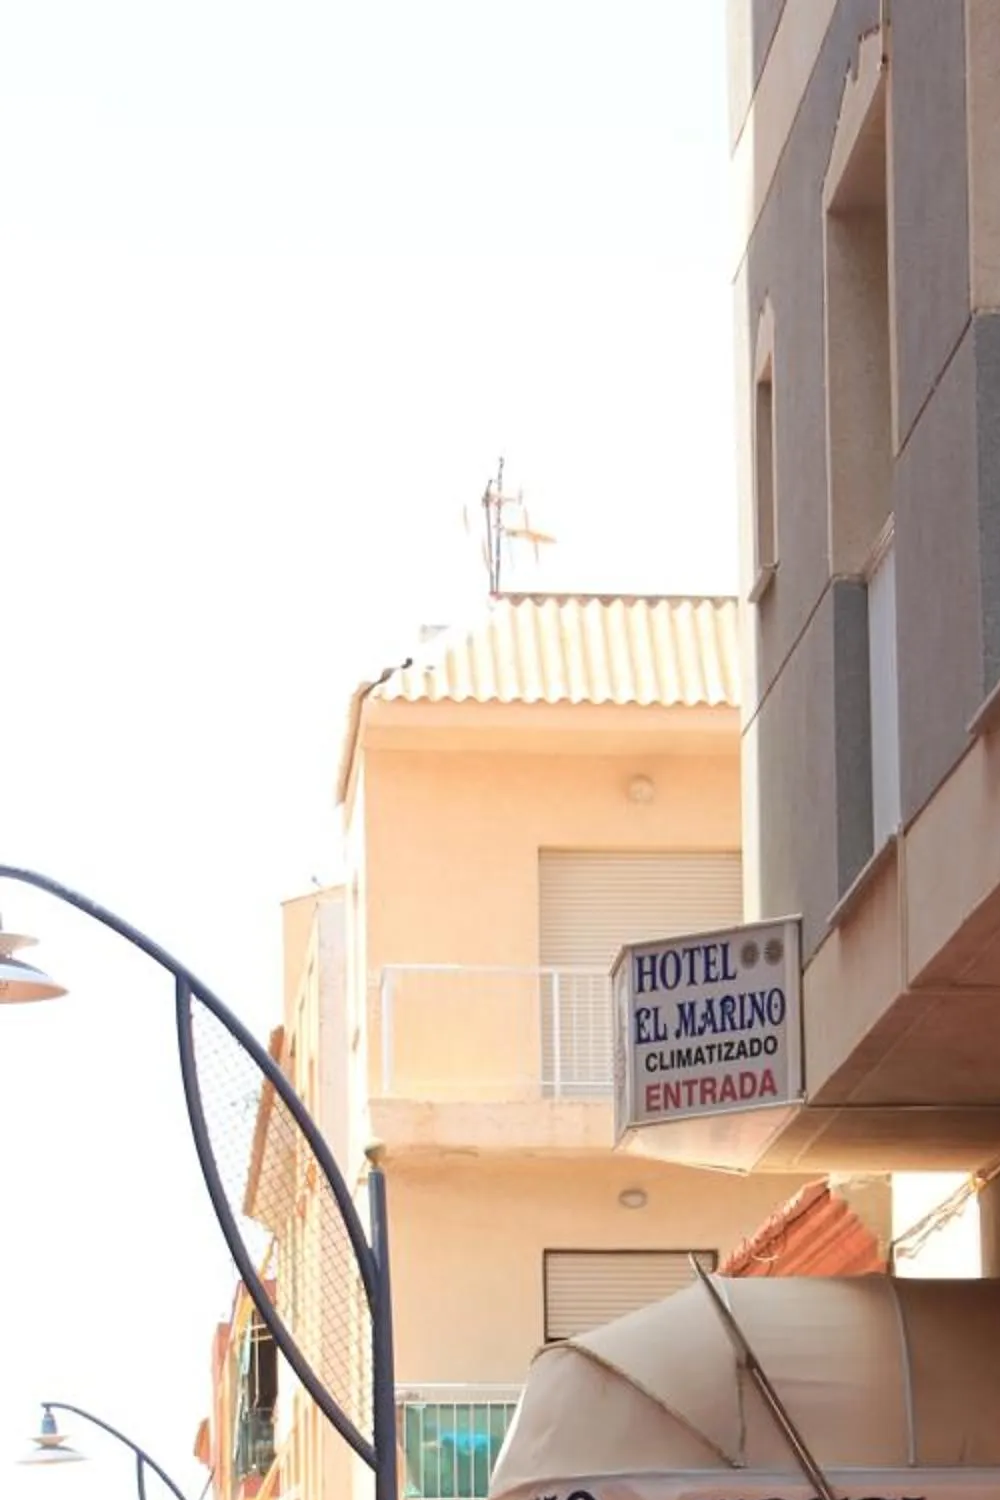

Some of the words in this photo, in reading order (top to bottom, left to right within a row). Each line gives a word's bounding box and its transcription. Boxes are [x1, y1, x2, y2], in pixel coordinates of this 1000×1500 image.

[635, 943, 737, 994] HOTEL
[634, 1006, 668, 1045] EL
[675, 987, 787, 1040] MARINO
[645, 1035, 778, 1073] CLIMATIZADO
[645, 1069, 778, 1113] ENTRADA
